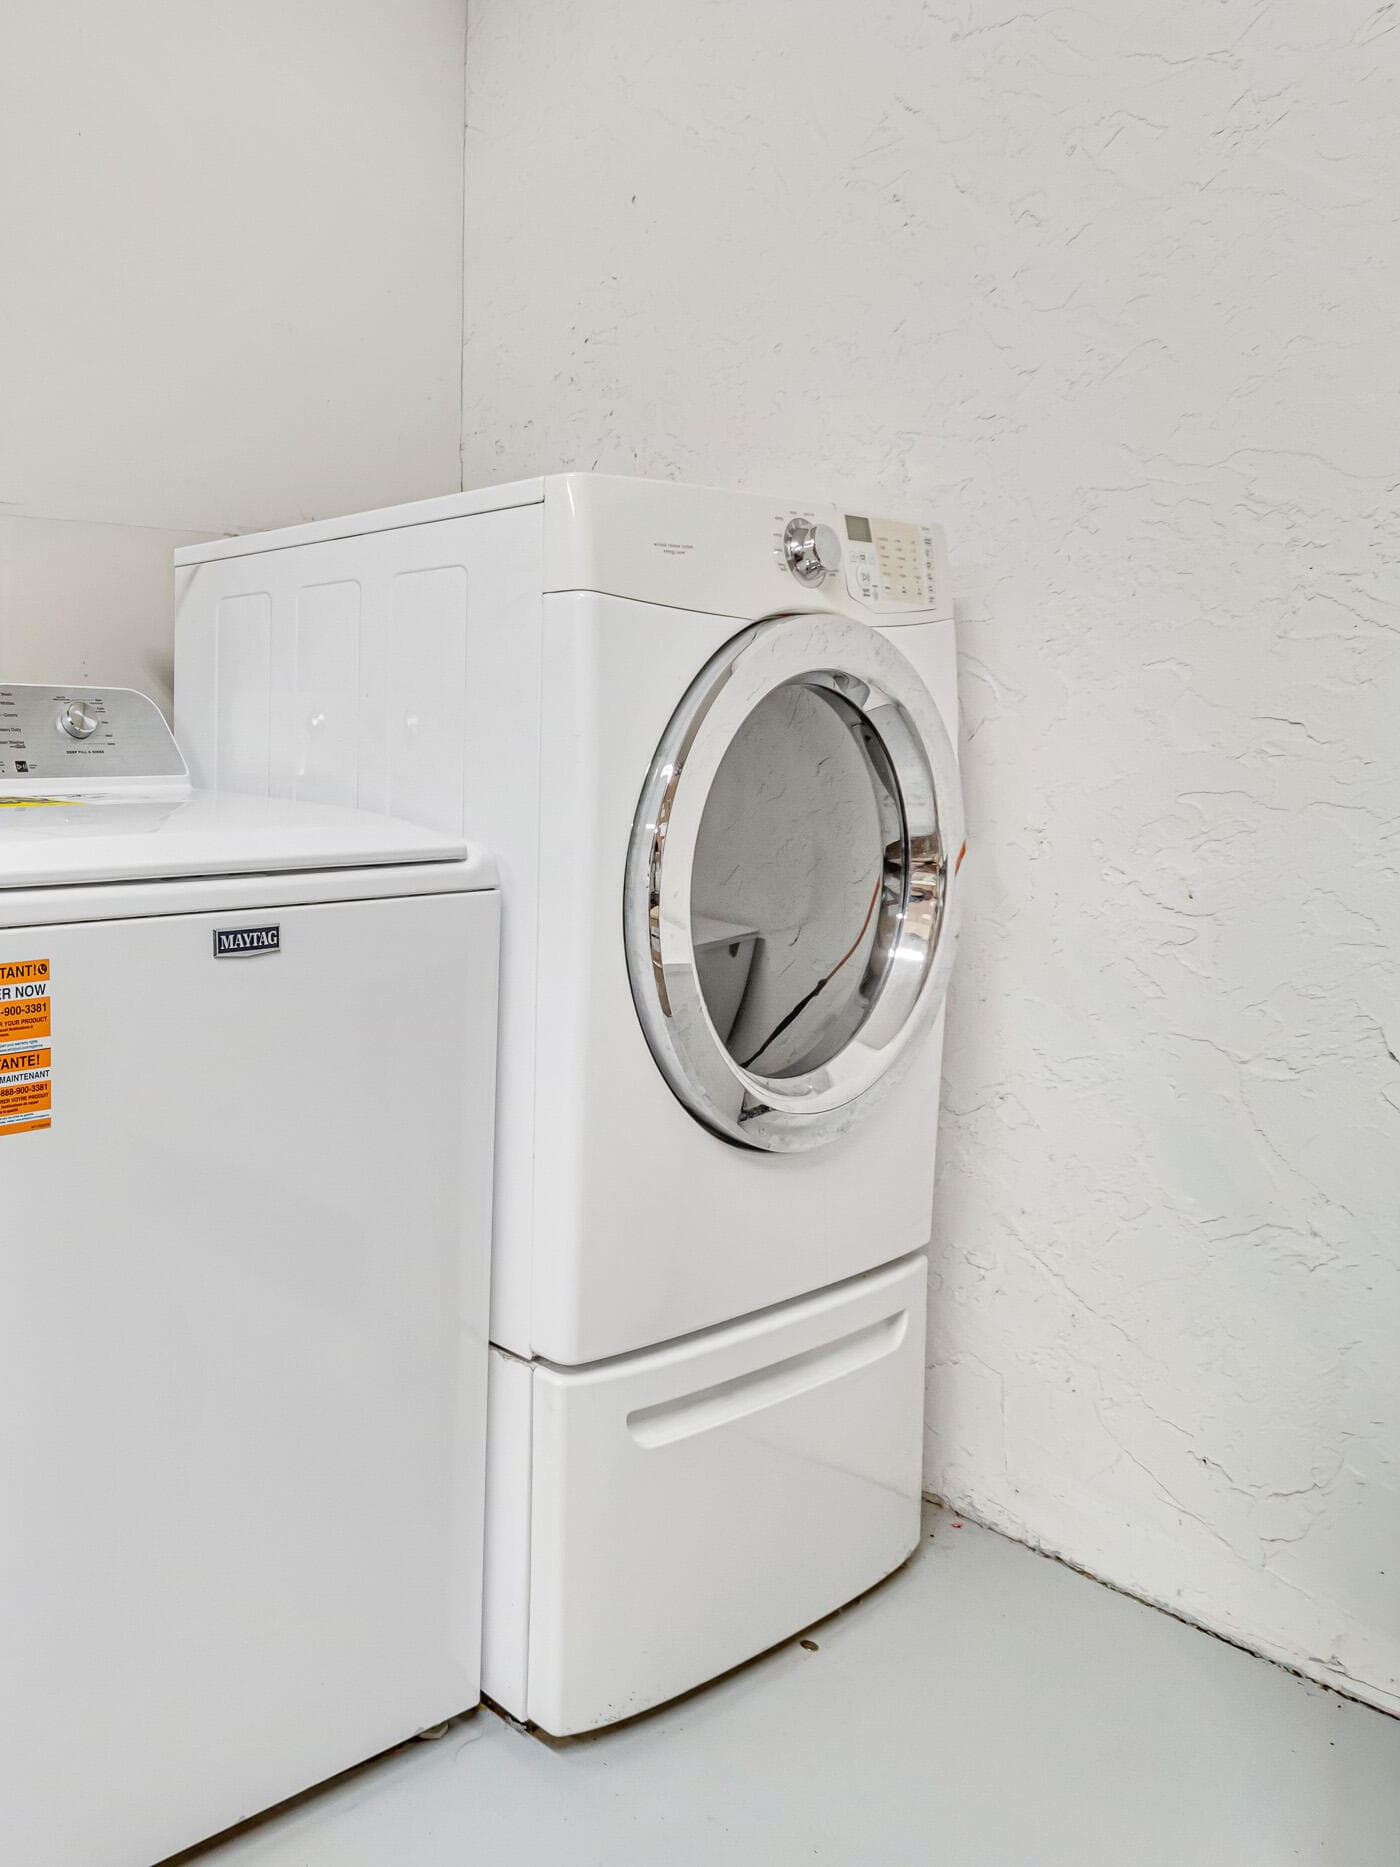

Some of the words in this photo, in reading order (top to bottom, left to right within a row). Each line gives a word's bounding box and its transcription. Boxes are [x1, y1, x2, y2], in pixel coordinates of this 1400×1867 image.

[220, 930, 278, 950] MAYTAG
[15, 984, 47, 998] NOW
[20, 1016, 48, 1025] PRODUCT
[0, 1069, 50, 1084] MAINTENANT
